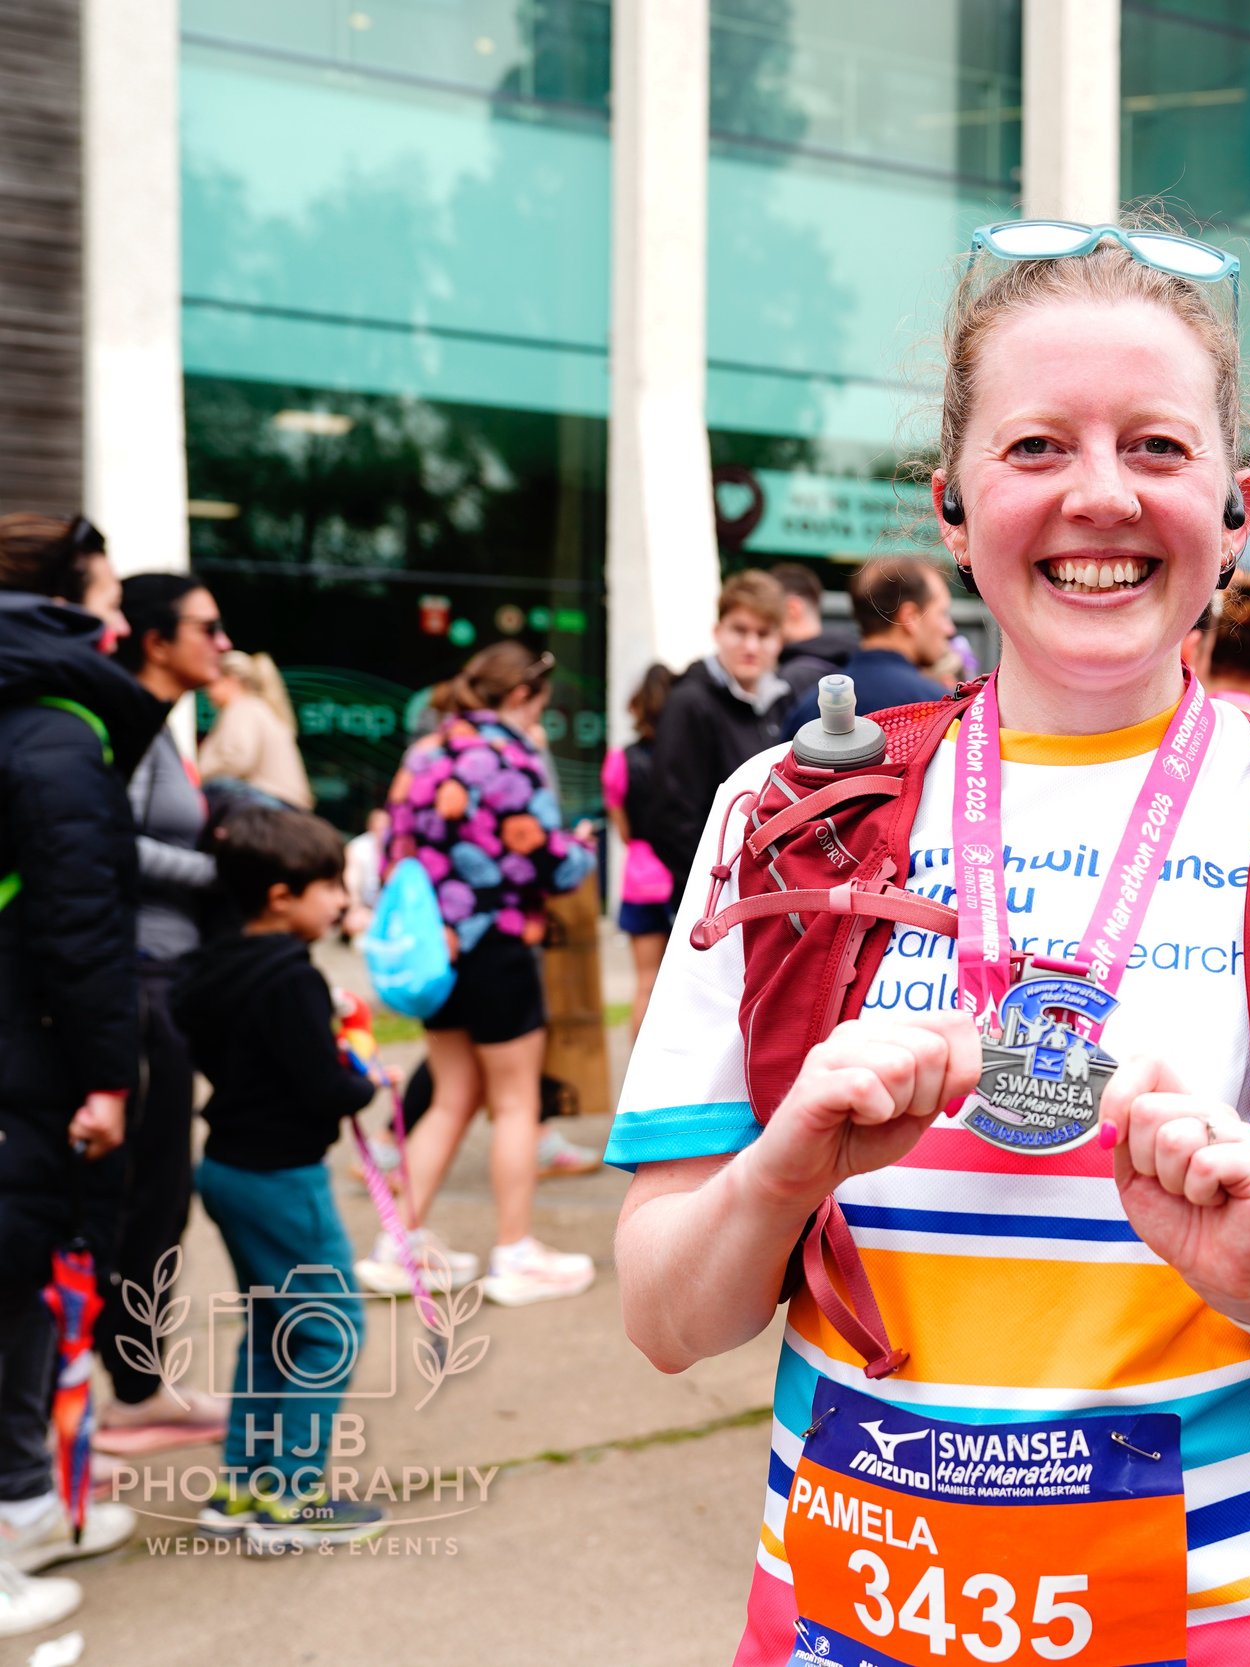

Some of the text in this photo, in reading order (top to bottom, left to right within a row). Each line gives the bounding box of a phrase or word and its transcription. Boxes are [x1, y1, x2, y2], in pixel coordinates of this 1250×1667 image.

[964, 776, 987, 823] 2026
[815, 826, 850, 869] OSPREY
[963, 866, 979, 910] EVENTS LTD
[1089, 792, 1174, 990] alf Marathon 2026
[1042, 938, 1245, 976] reearch
[995, 1072, 1093, 1106] SWANSEA
[972, 1114, 1085, 1146] #RUNSWANSEA
[1023, 1111, 1056, 1128] 2026
[938, 1430, 1090, 1461] SWANSEA
[937, 1483, 1091, 1498] HANNER MARATHON ABERTAWE
[792, 1476, 938, 1555] PAMELA
[847, 1549, 1092, 1663] 3435
